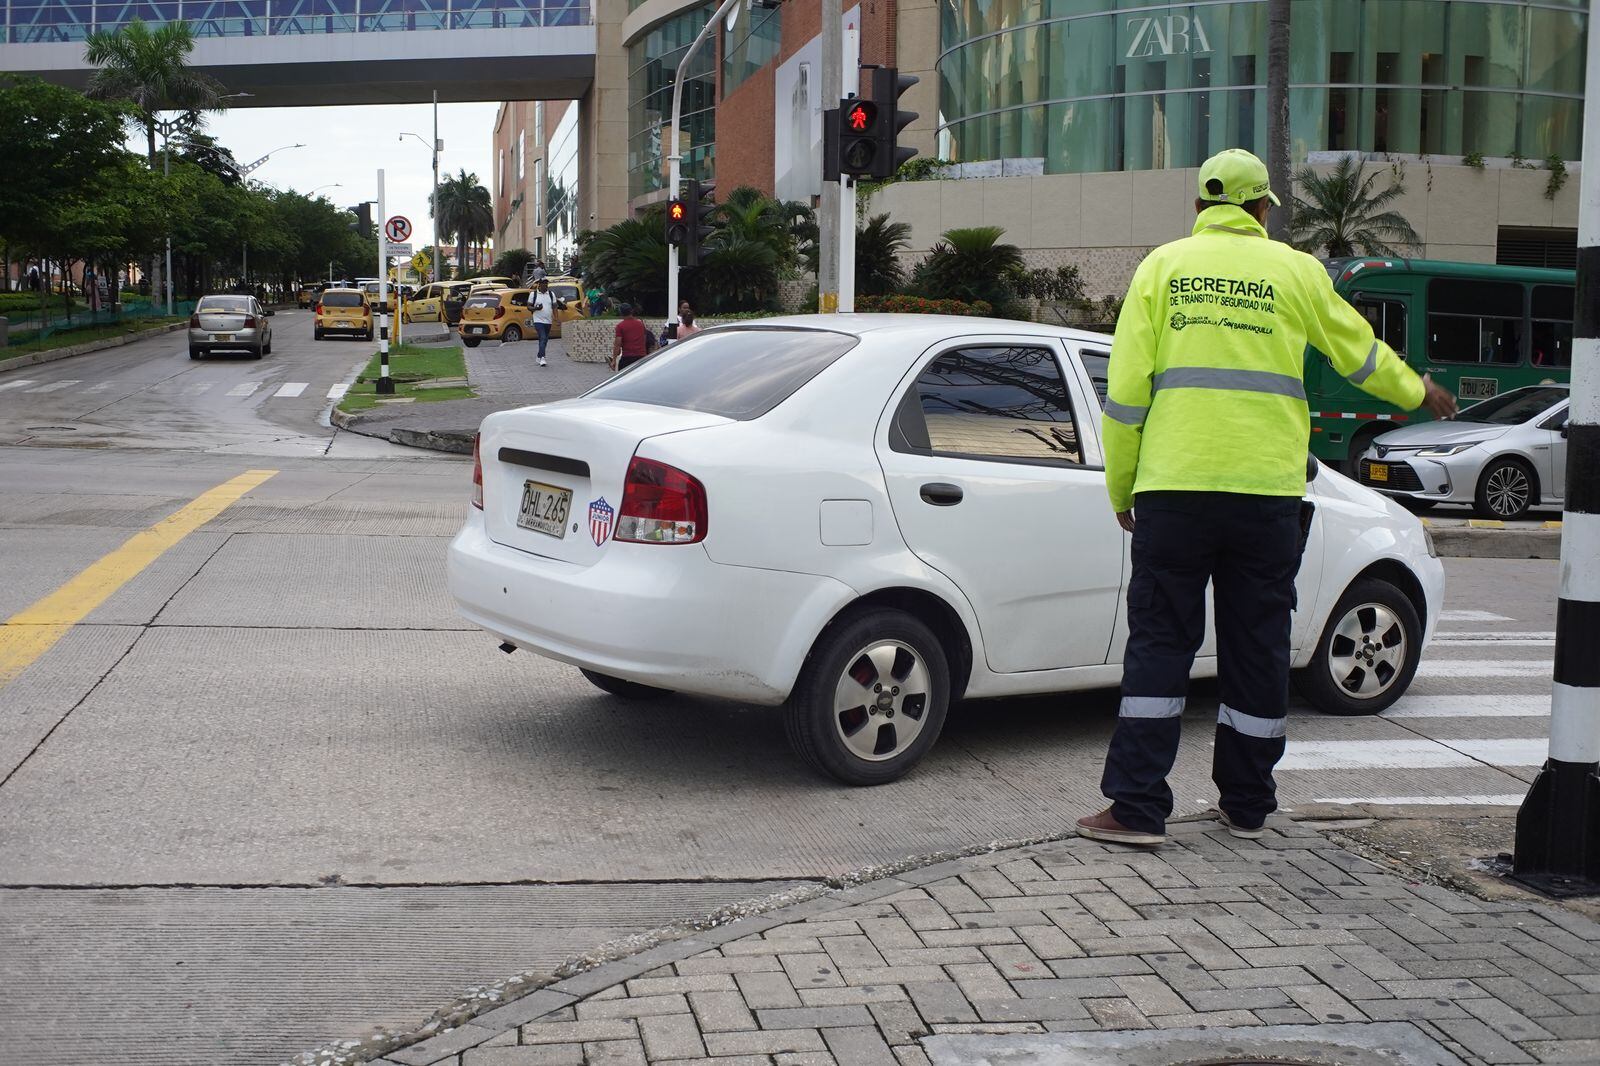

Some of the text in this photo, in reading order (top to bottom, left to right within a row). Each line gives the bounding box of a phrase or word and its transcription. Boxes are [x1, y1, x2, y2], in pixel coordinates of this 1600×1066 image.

[1125, 14, 1216, 57] ZARA
[393, 219, 406, 238] P
[1169, 277, 1275, 301] SECRETARÍA
[1170, 292, 1275, 314] DE TRÁNSITO Y SEGURIDAD VIAL
[1480, 383, 1495, 396] 246
[543, 494, 568, 524] 265
